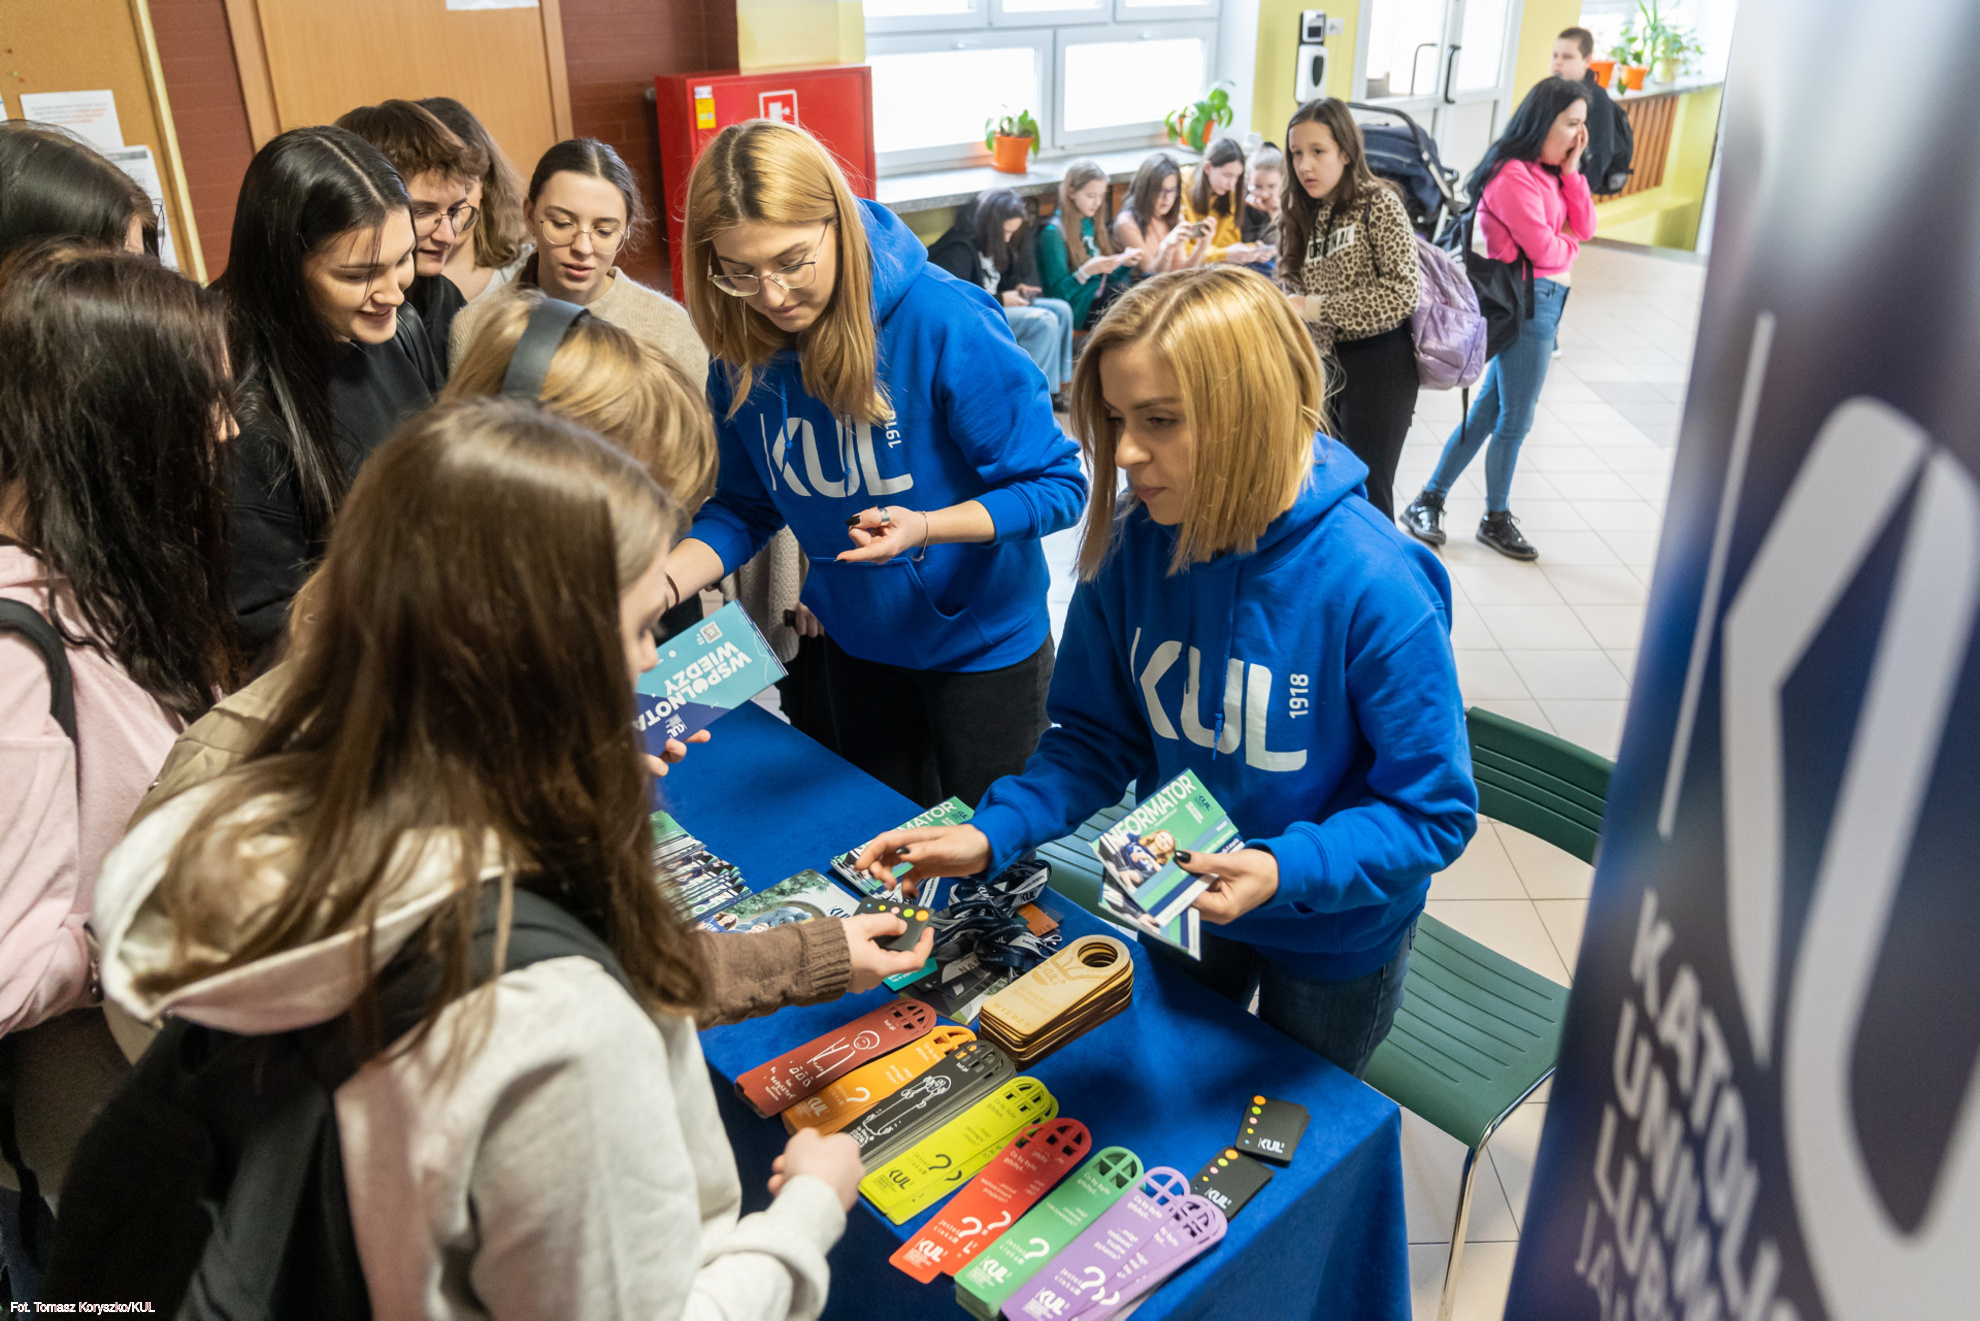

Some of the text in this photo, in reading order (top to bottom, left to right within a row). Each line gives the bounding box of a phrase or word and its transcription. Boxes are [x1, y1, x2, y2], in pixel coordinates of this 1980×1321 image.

[760, 413, 914, 497] KUL
[664, 641, 740, 697] WIEDZY
[1130, 627, 1307, 772] KUL
[1289, 673, 1309, 719] 1918
[1100, 775, 1197, 855] INFORMATOR
[1258, 1137, 1283, 1153] KUL
[888, 1167, 911, 1190] KUL
[1205, 1187, 1229, 1210] KUL
[916, 1236, 943, 1263] KUL
[979, 1255, 1008, 1284] KUL
[1035, 1286, 1066, 1317] KUL
